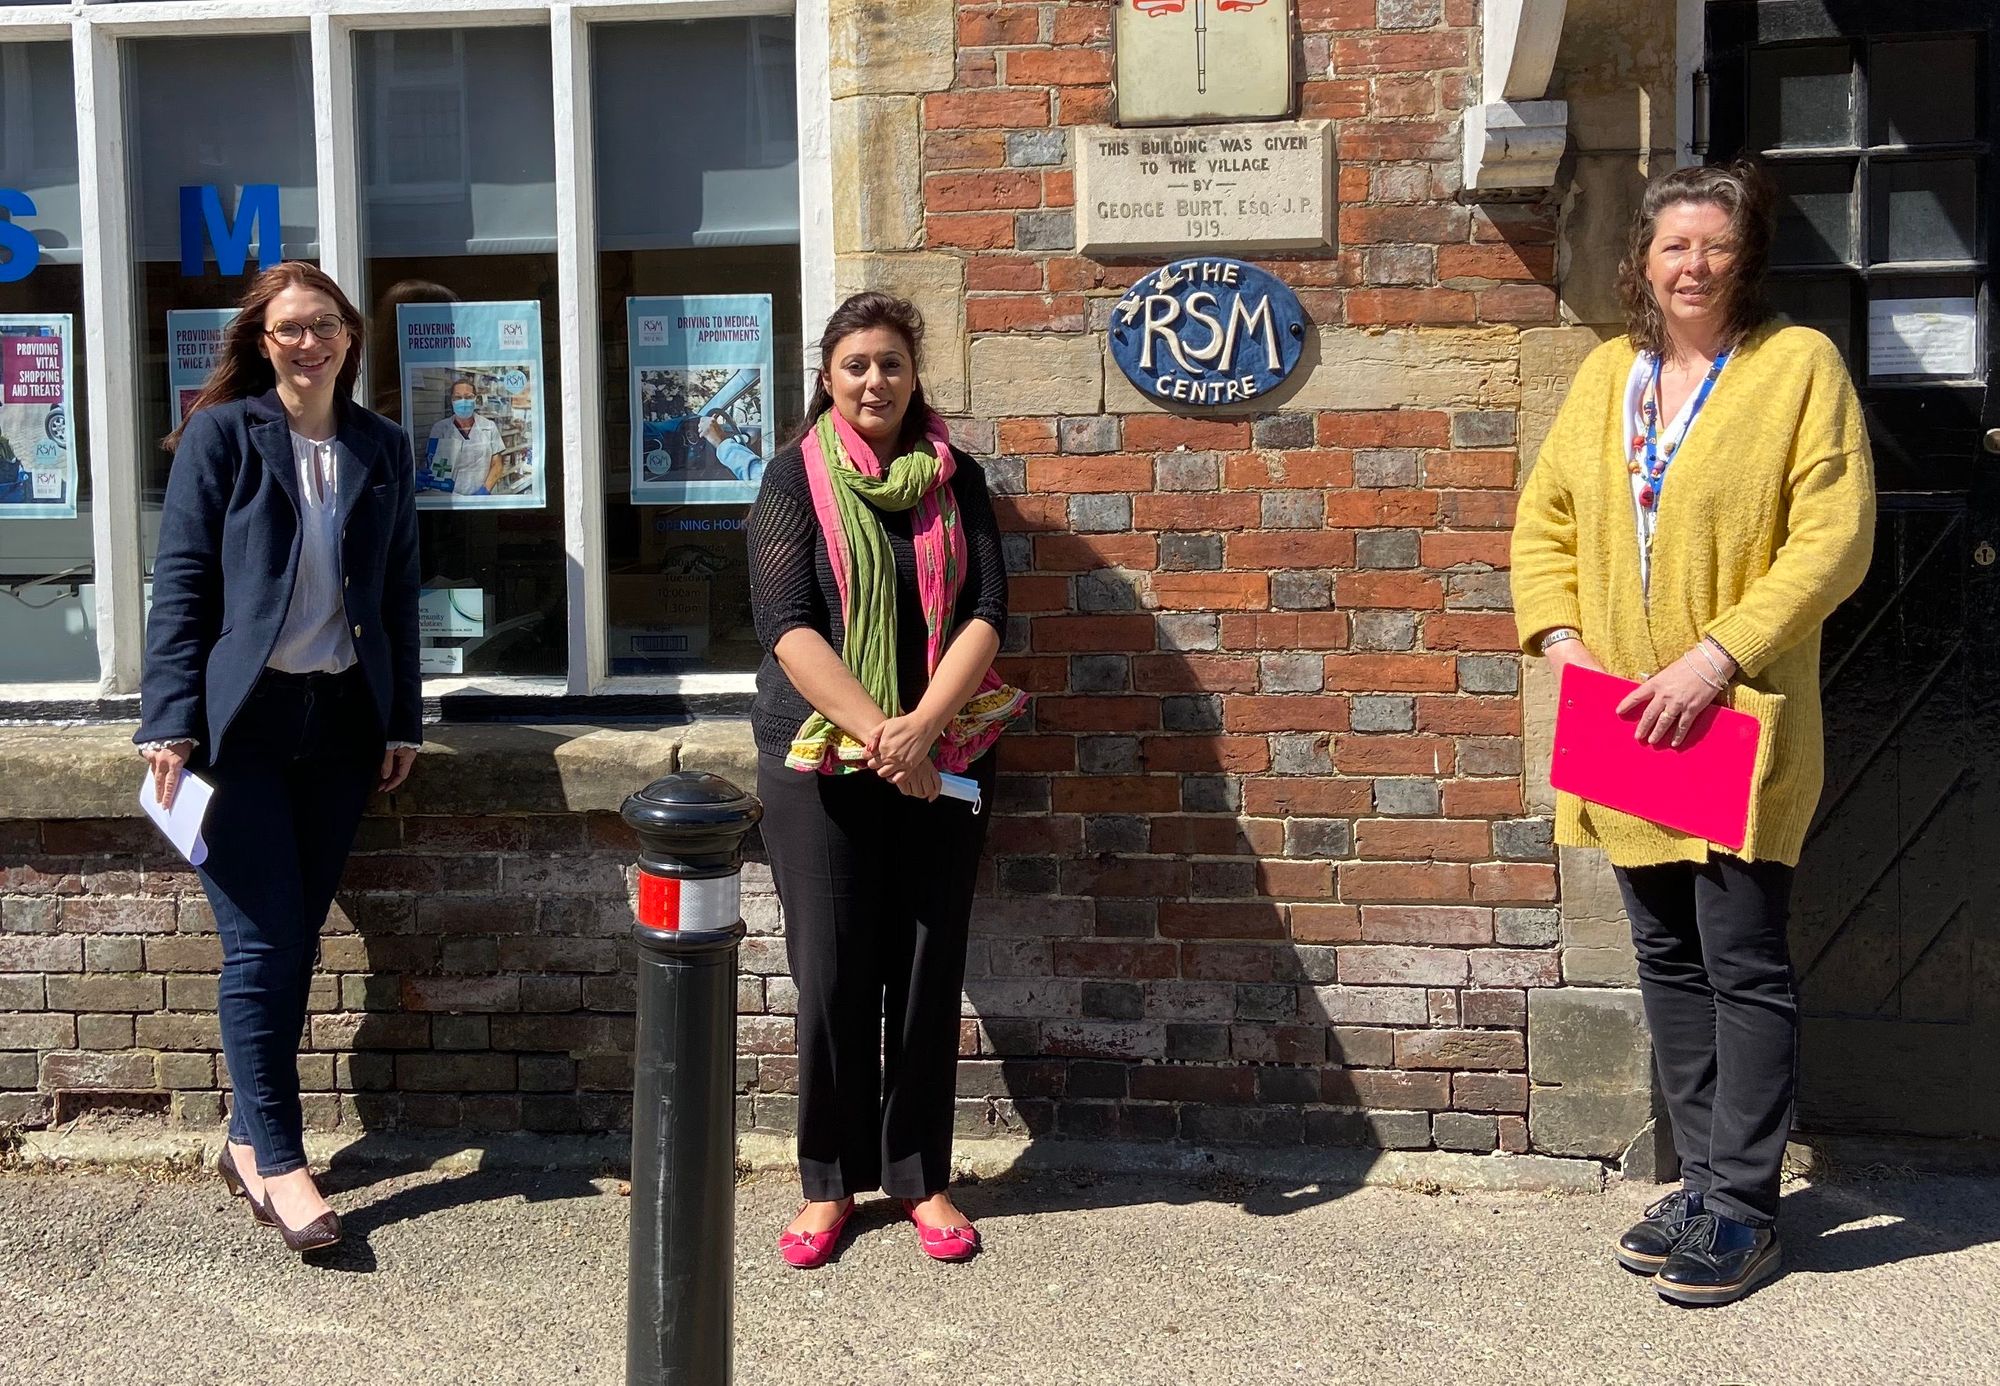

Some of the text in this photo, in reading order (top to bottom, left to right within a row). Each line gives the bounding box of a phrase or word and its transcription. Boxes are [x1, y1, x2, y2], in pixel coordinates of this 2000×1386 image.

[1099, 136, 1308, 156] THIS BUILDING WAS GIVEN
[1140, 158, 1270, 175] TO THE VILLAGE
[1193, 179, 1213, 192] BY
[1097, 201, 1164, 219] GEORGE
[179, 183, 283, 277] M
[1180, 262, 1240, 284] THE
[408, 322, 455, 335] DELIVERING
[643, 320, 663, 331] RSM
[677, 315, 760, 329] DRIVING TO MEDICAL
[176, 329, 221, 342] PROVIDING
[503, 323, 523, 336] RSM
[698, 329, 760, 342] APPOINTMENTS
[1139, 291, 1281, 374] RSM
[16, 343, 59, 356] PROVIDING
[177, 343, 197, 355] FEED
[199, 343, 207, 355] IT
[408, 337, 472, 350] PRESCRIPTIONS
[36, 356, 60, 369] VITAL
[177, 357, 204, 369] TWICE
[205, 357, 211, 369] A
[19, 370, 60, 384] SHOPPING
[506, 376, 524, 387] RSM
[12, 384, 61, 397] AND TREATS
[1156, 375, 1257, 402] CENTRE
[36, 443, 57, 457] RSM
[37, 472, 57, 485] RSM
